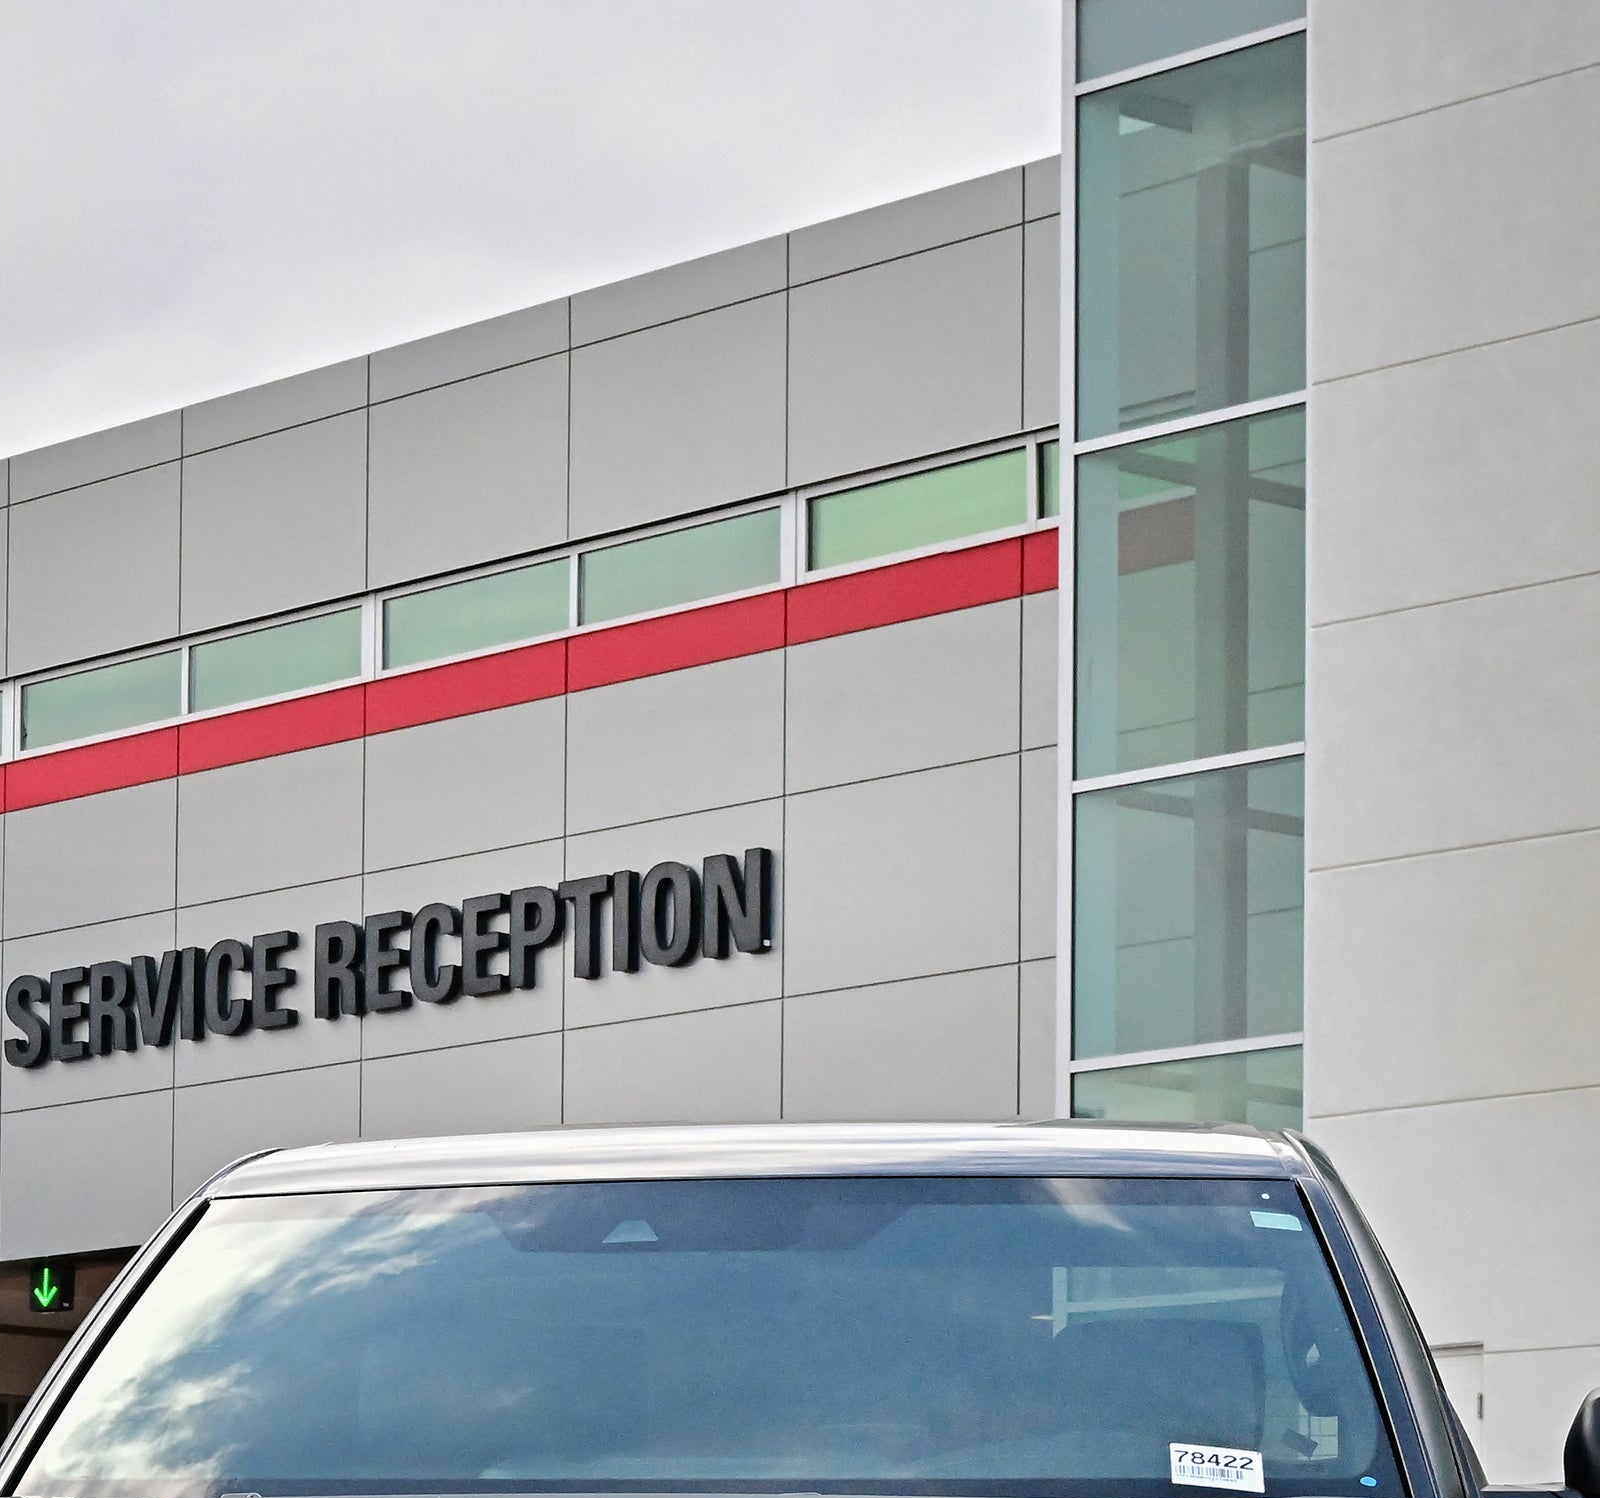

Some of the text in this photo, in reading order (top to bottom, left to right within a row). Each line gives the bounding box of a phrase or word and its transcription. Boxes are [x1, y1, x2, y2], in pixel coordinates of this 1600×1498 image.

[4, 847, 773, 1068] SERVICE RECEPTION
[1174, 1449, 1254, 1471] 78422
